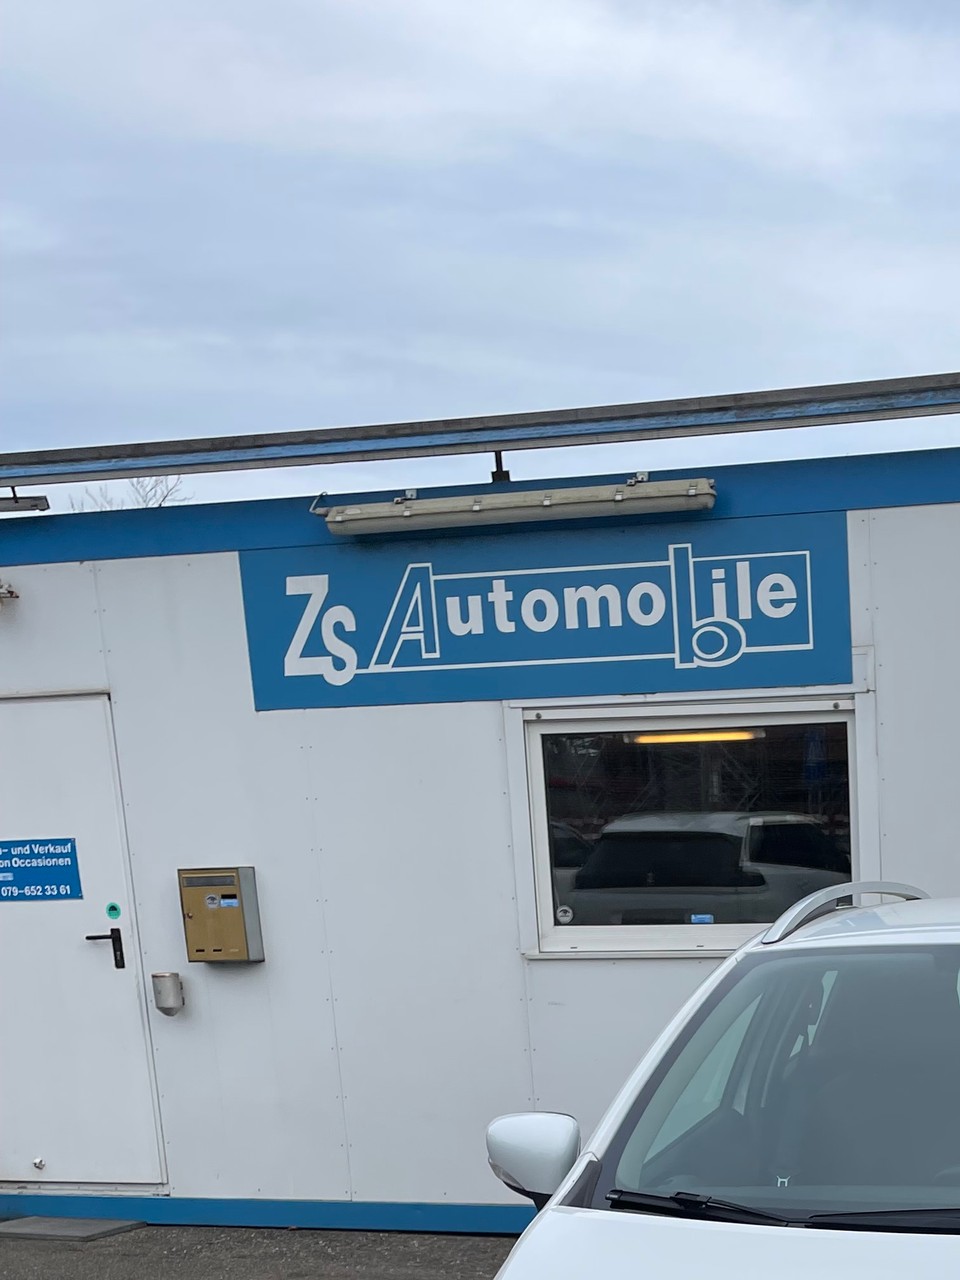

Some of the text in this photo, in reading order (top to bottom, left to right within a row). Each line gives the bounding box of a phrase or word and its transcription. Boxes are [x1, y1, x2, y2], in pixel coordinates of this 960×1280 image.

[284, 543, 798, 686] Zs Automobile
[11, 844, 30, 854] und
[31, 843, 71, 854] Verkauf
[12, 856, 71, 867] Occasionen
[45, 885, 57, 895] 33
[59, 885, 71, 895] 61
